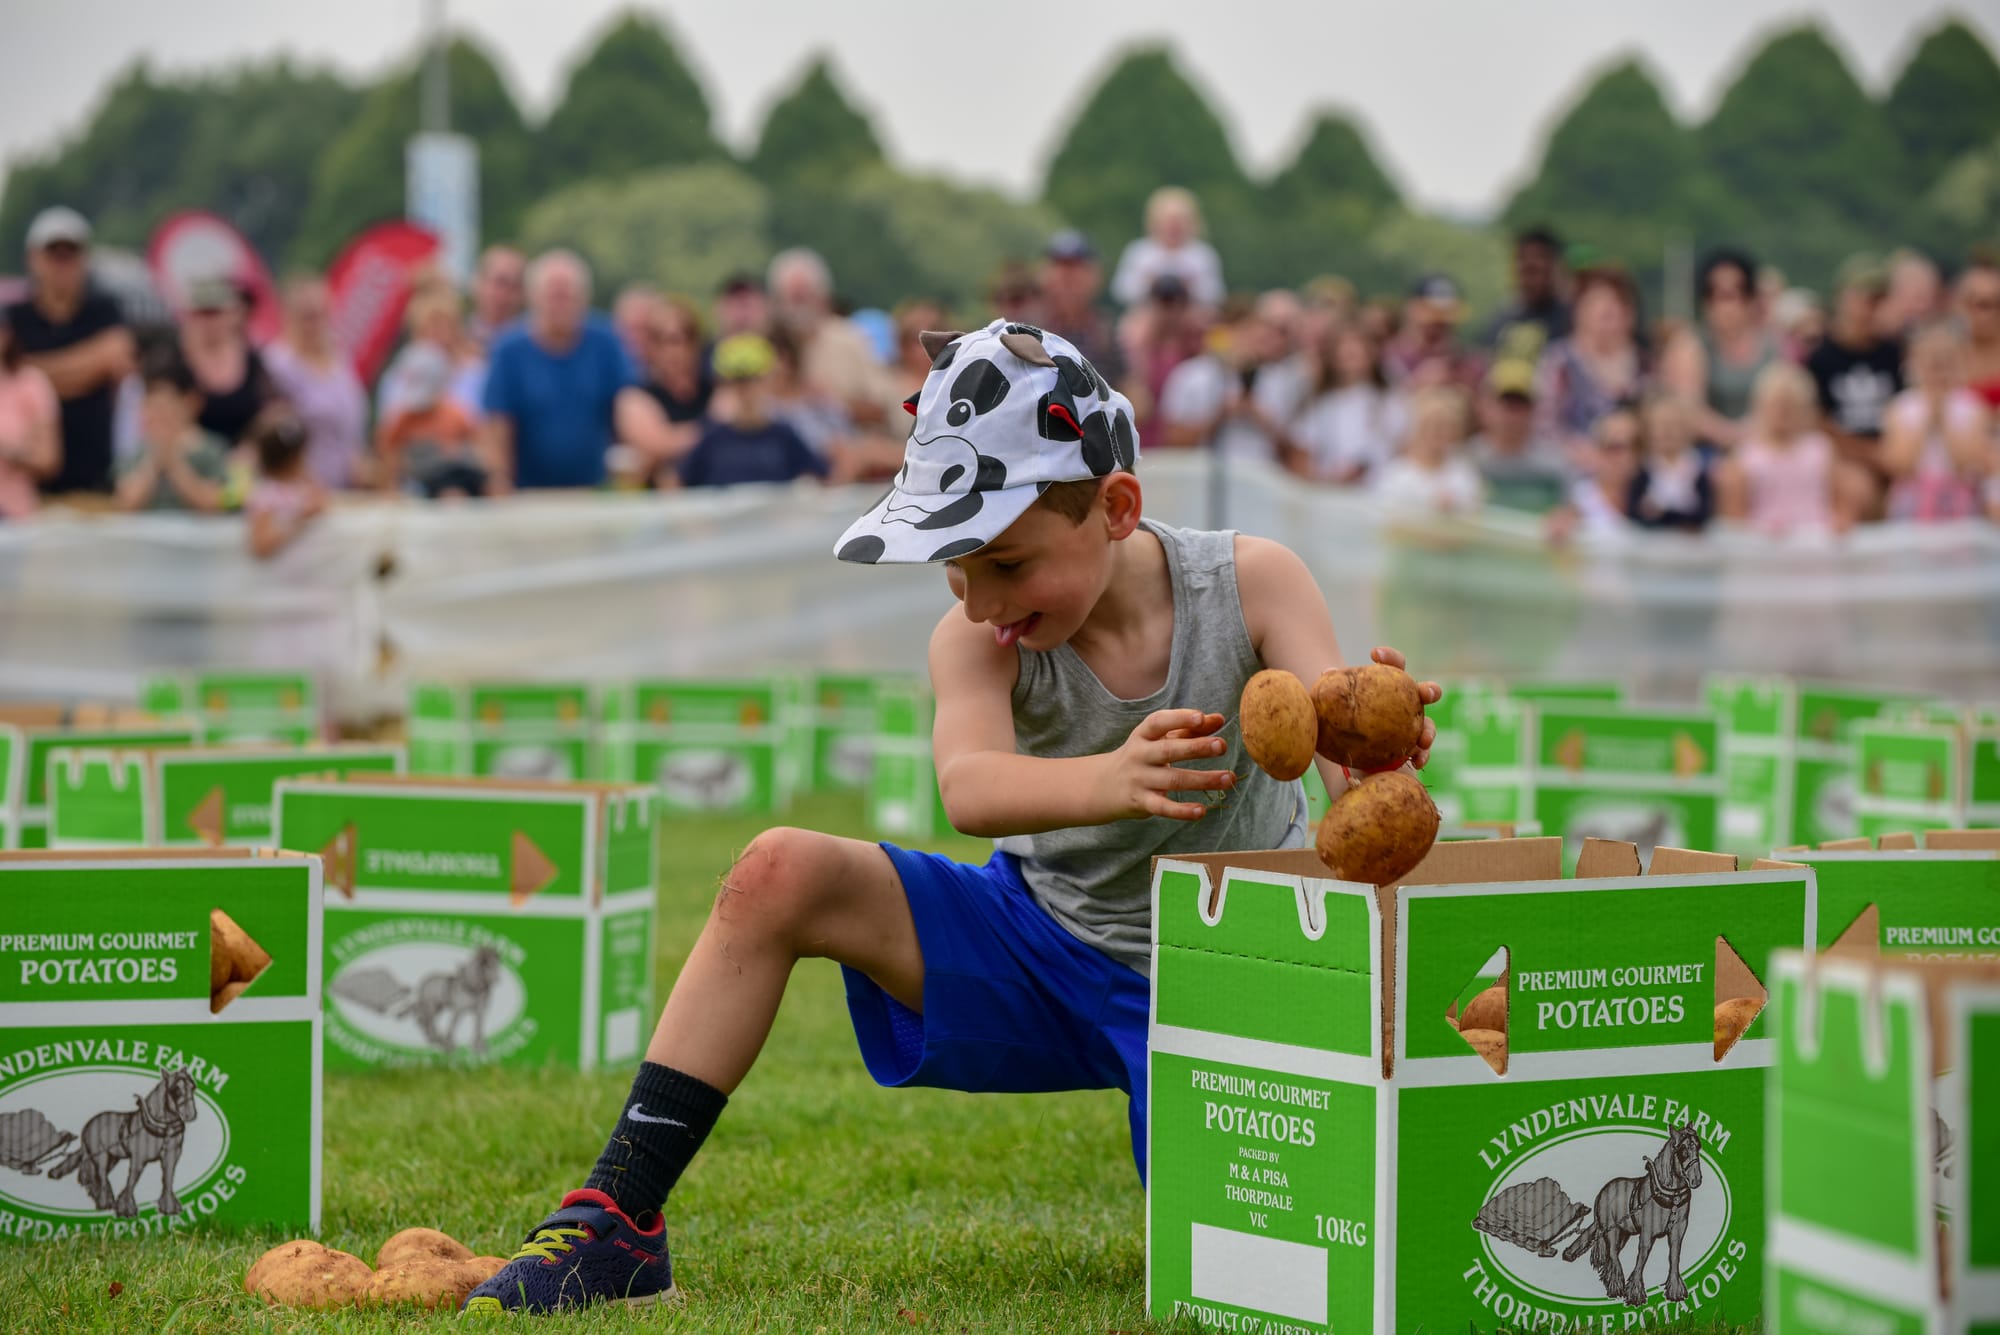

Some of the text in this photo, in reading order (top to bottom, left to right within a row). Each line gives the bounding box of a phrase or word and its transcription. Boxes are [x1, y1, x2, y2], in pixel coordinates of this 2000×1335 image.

[1, 931, 198, 951] PREMIUM GOURMET
[1886, 927, 1974, 945] PREMIUM
[20, 958, 177, 984] POTATOES
[1518, 963, 1704, 991] PREMIUM GOURMET
[1537, 995, 1685, 1030] POTATOES
[154, 1045, 229, 1093] FARM
[1192, 1070, 1331, 1110] PREMIUM GOURMET
[1205, 1102, 1316, 1147] POTATOES
[1478, 1094, 1732, 1170] LYNDENVALE FARM
[1239, 1147, 1280, 1163] PACKED BY
[1229, 1163, 1289, 1188] M & A PISA
[114, 1164, 246, 1240] POTATOES
[1225, 1185, 1293, 1211] THORPDALE
[1249, 1211, 1268, 1229] VIC
[1314, 1214, 1367, 1247] 10KG
[1463, 1258, 1615, 1335] THORPDALE
[1174, 1300, 1239, 1332] PRODUCT
[1264, 1320, 1332, 1335] AUST
